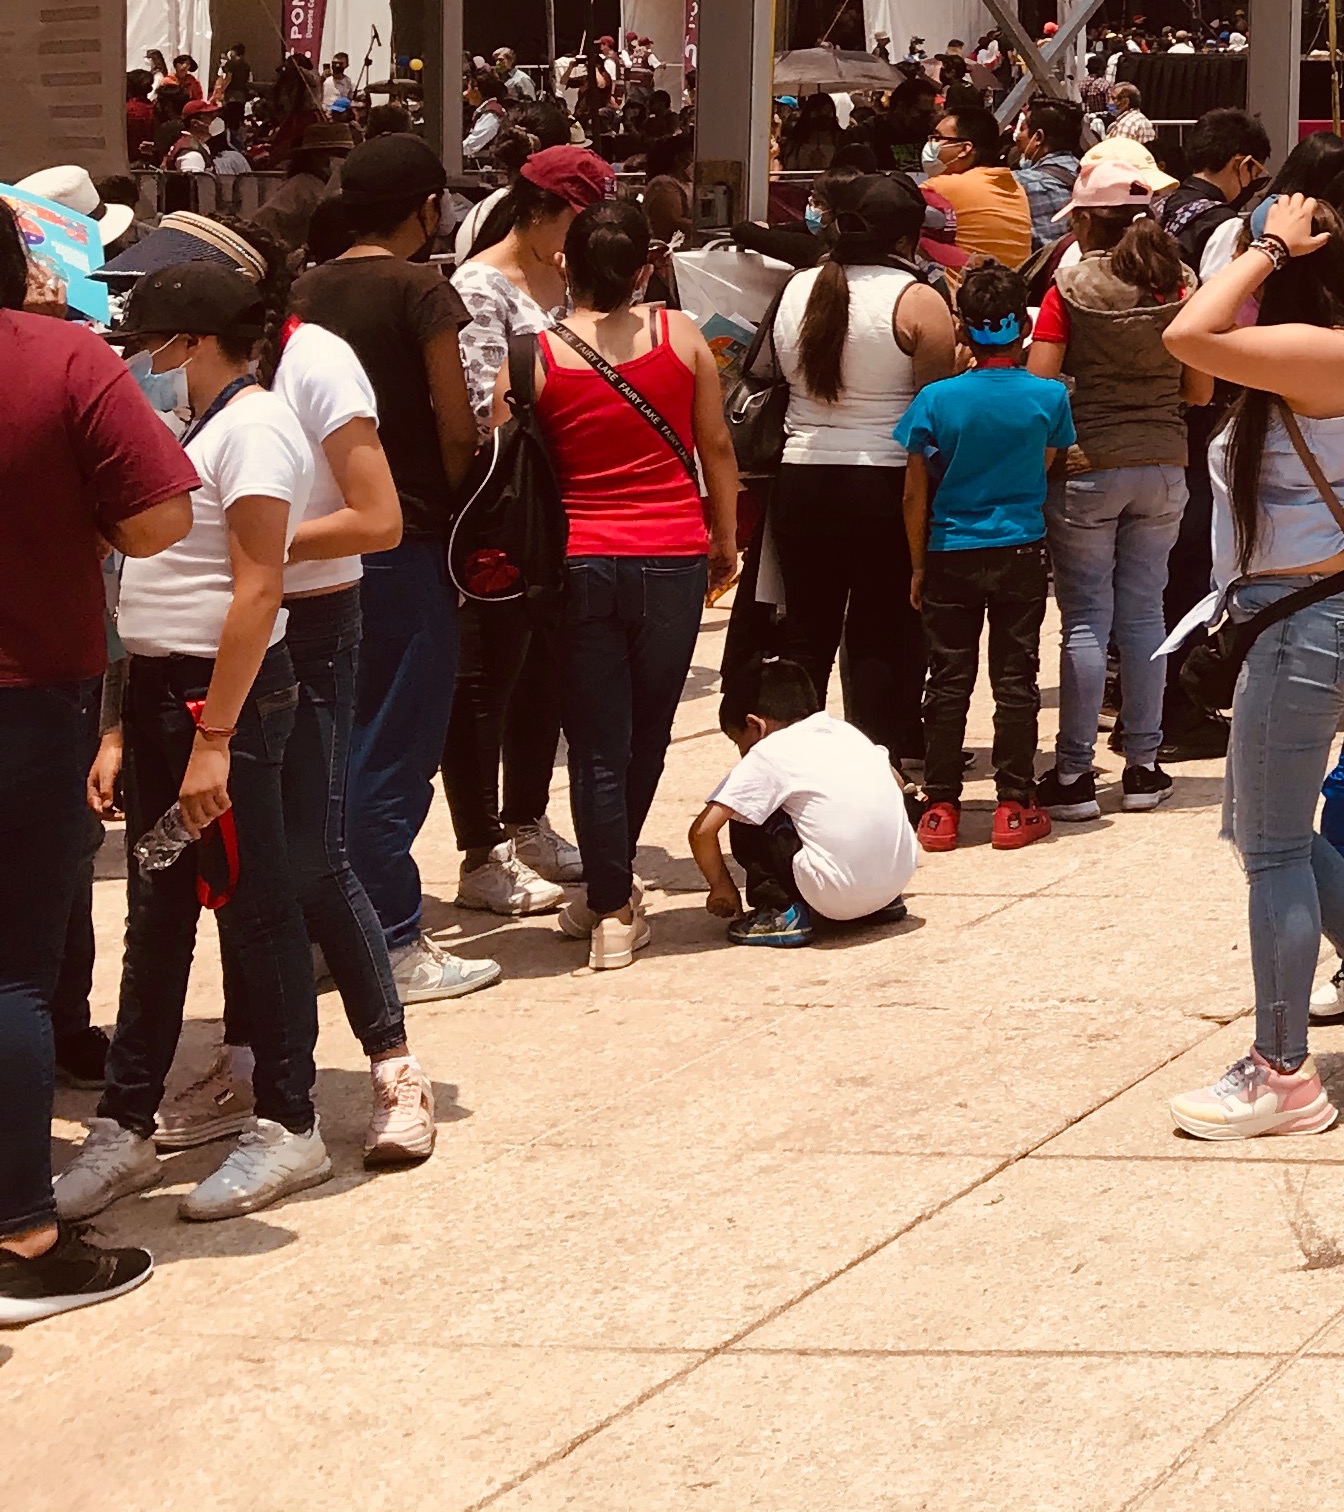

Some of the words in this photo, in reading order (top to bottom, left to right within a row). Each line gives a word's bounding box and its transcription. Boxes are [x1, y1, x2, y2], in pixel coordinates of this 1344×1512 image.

[576, 340, 599, 362] FAIRY
[597, 361, 619, 382] LAKE
[618, 382, 643, 405] FAIRY
[640, 403, 661, 425] LAKE
